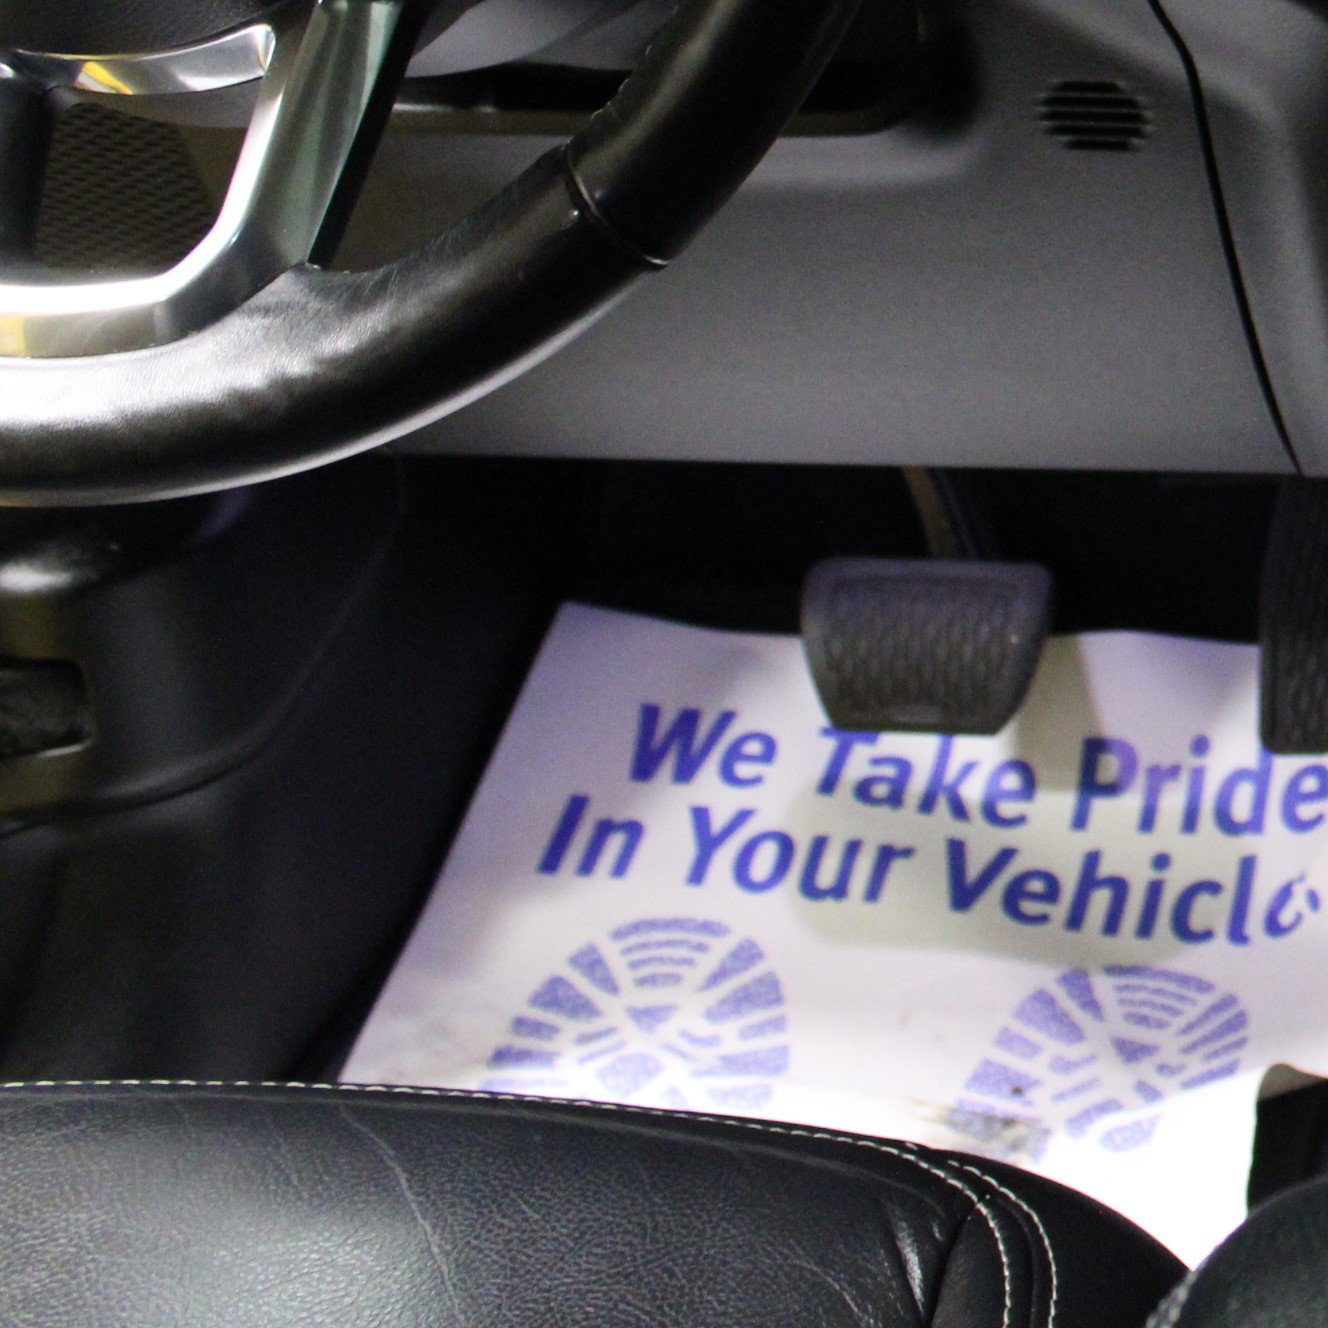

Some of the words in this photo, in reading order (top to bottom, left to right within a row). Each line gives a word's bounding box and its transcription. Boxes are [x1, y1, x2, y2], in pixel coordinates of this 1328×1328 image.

[628, 702, 780, 789] We
[813, 725, 1037, 829] Take
[534, 793, 646, 878] In
[684, 805, 914, 904] Your
